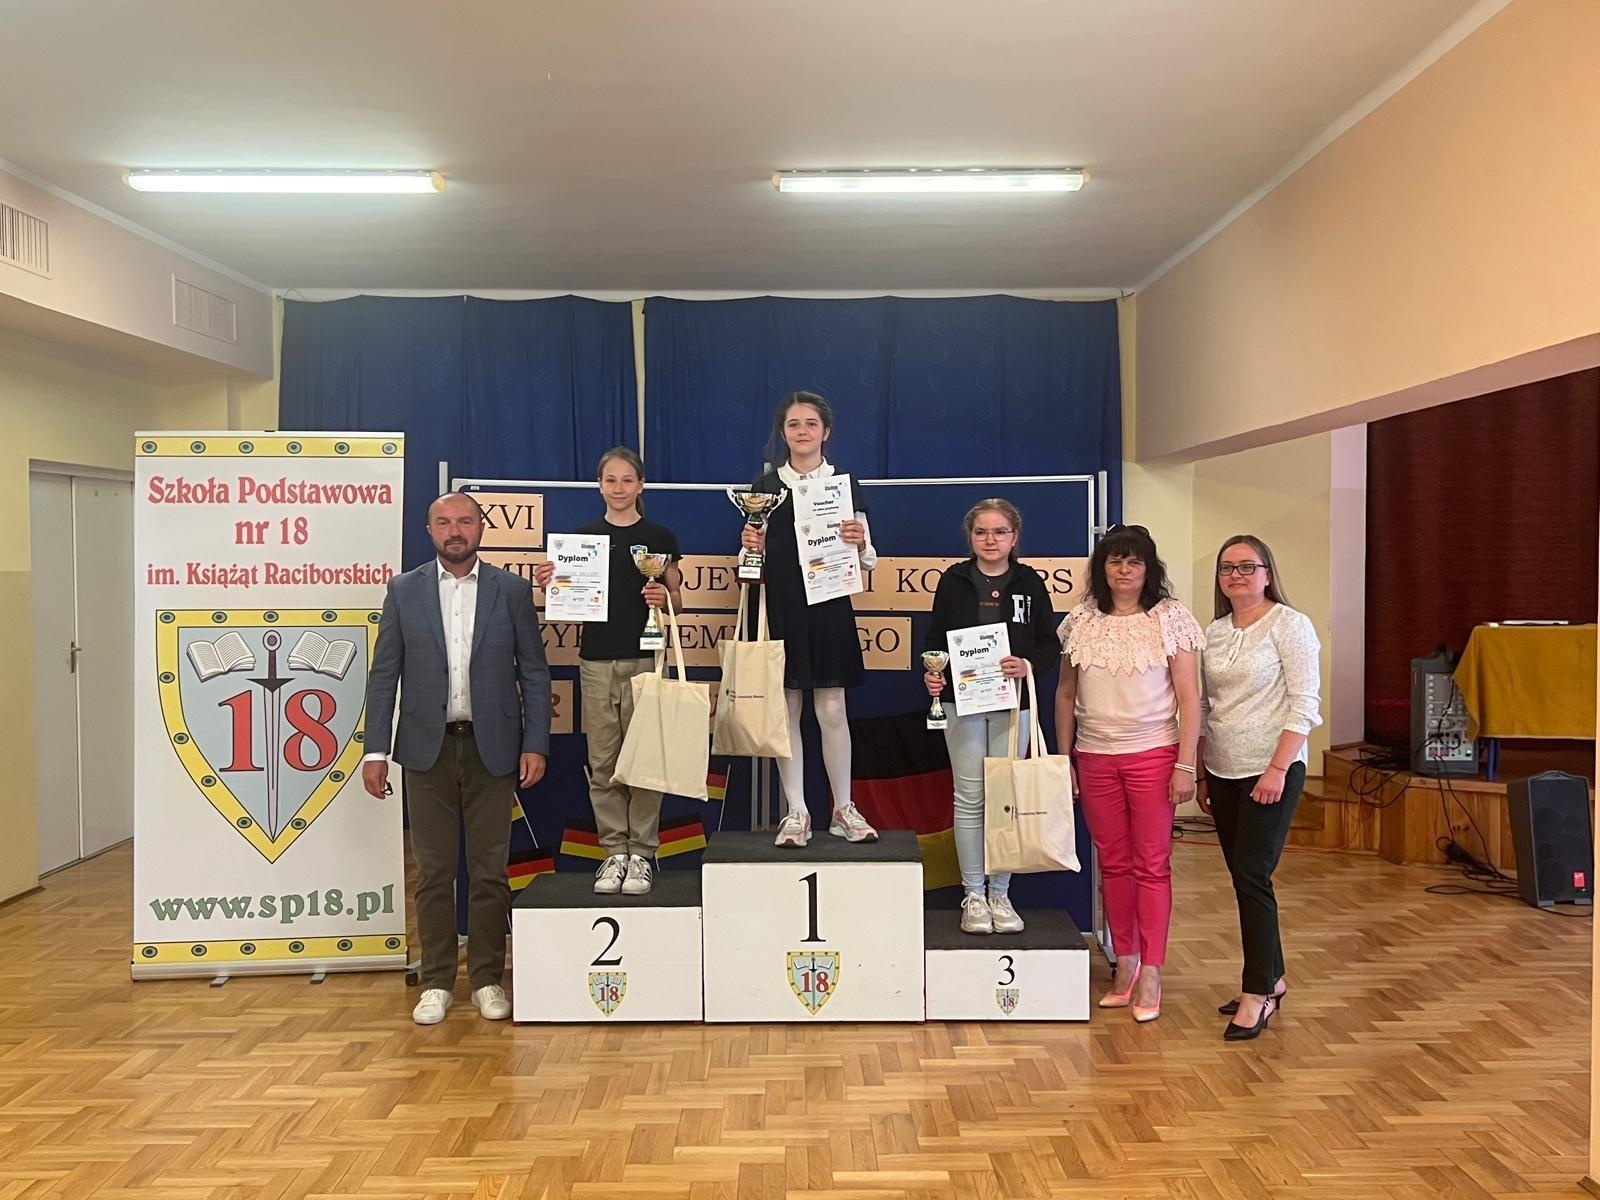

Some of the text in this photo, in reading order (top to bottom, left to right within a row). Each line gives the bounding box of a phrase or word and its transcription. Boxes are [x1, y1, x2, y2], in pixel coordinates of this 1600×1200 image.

[148, 475, 393, 504] Szkoła Podstawowa
[235, 516, 308, 545] nr 18
[808, 535, 836, 547] Dyplom
[558, 554, 589, 563] Dyplom
[147, 562, 393, 588] im. Książąt Raciborskich
[960, 647, 990, 658] Dyplom
[218, 688, 338, 772] 18
[149, 884, 394, 924] www.sp18.pl
[798, 871, 826, 942] 1
[590, 916, 623, 966] 2
[801, 970, 830, 992] 18
[998, 954, 1015, 986] 3
[599, 986, 619, 1001] 18
